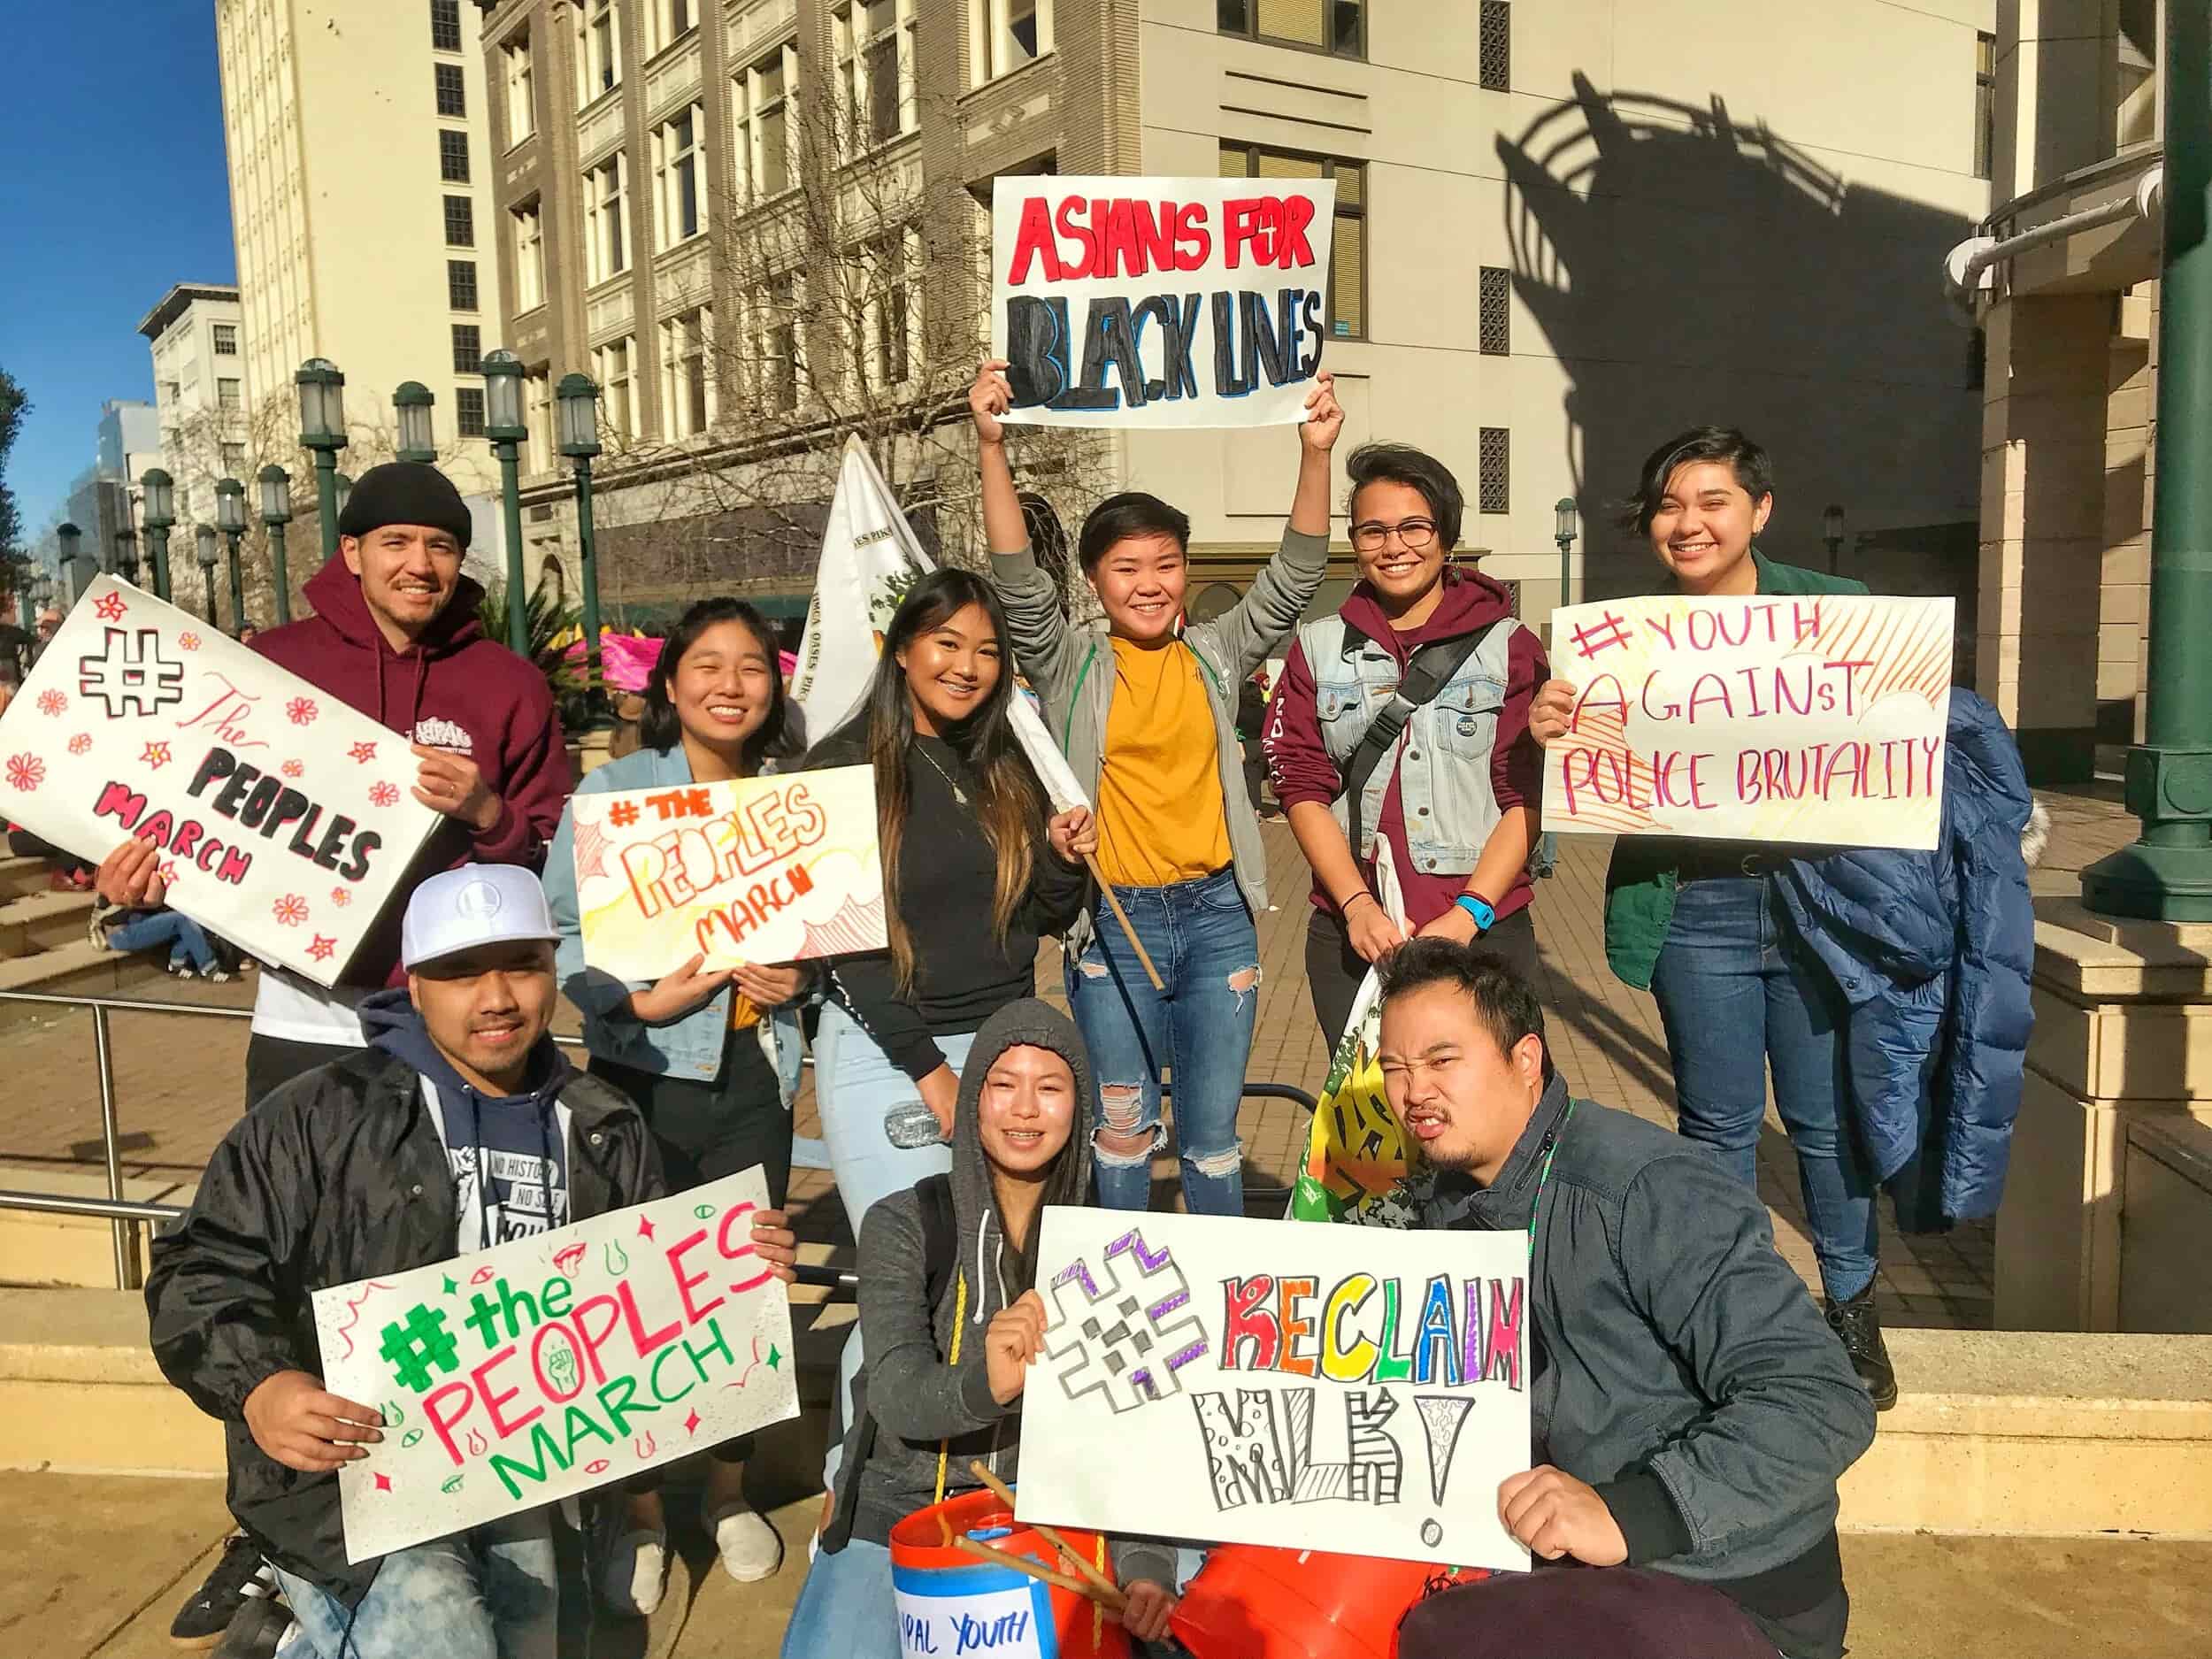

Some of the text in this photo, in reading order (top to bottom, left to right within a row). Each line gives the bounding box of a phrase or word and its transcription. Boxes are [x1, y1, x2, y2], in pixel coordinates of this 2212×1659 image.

[1008, 195, 1315, 285] ASIANS FOR
[1006, 292, 1202, 411] BLACK
[176, 671, 269, 749] The
[187, 747, 382, 881] PEOPLES
[1563, 736, 1939, 815] POLICE BRUTALITY
[93, 780, 252, 885] MARCH
[620, 783, 826, 918] PEOPLES
[695, 863, 814, 956] MARCH
[517, 1188, 532, 1206] NO
[423, 1202, 773, 1465] PEOPLES
[1219, 1271, 1524, 1391] RECLAIM
[489, 1317, 735, 1500] MARCH
[949, 1610, 1028, 1655] YOUTH
